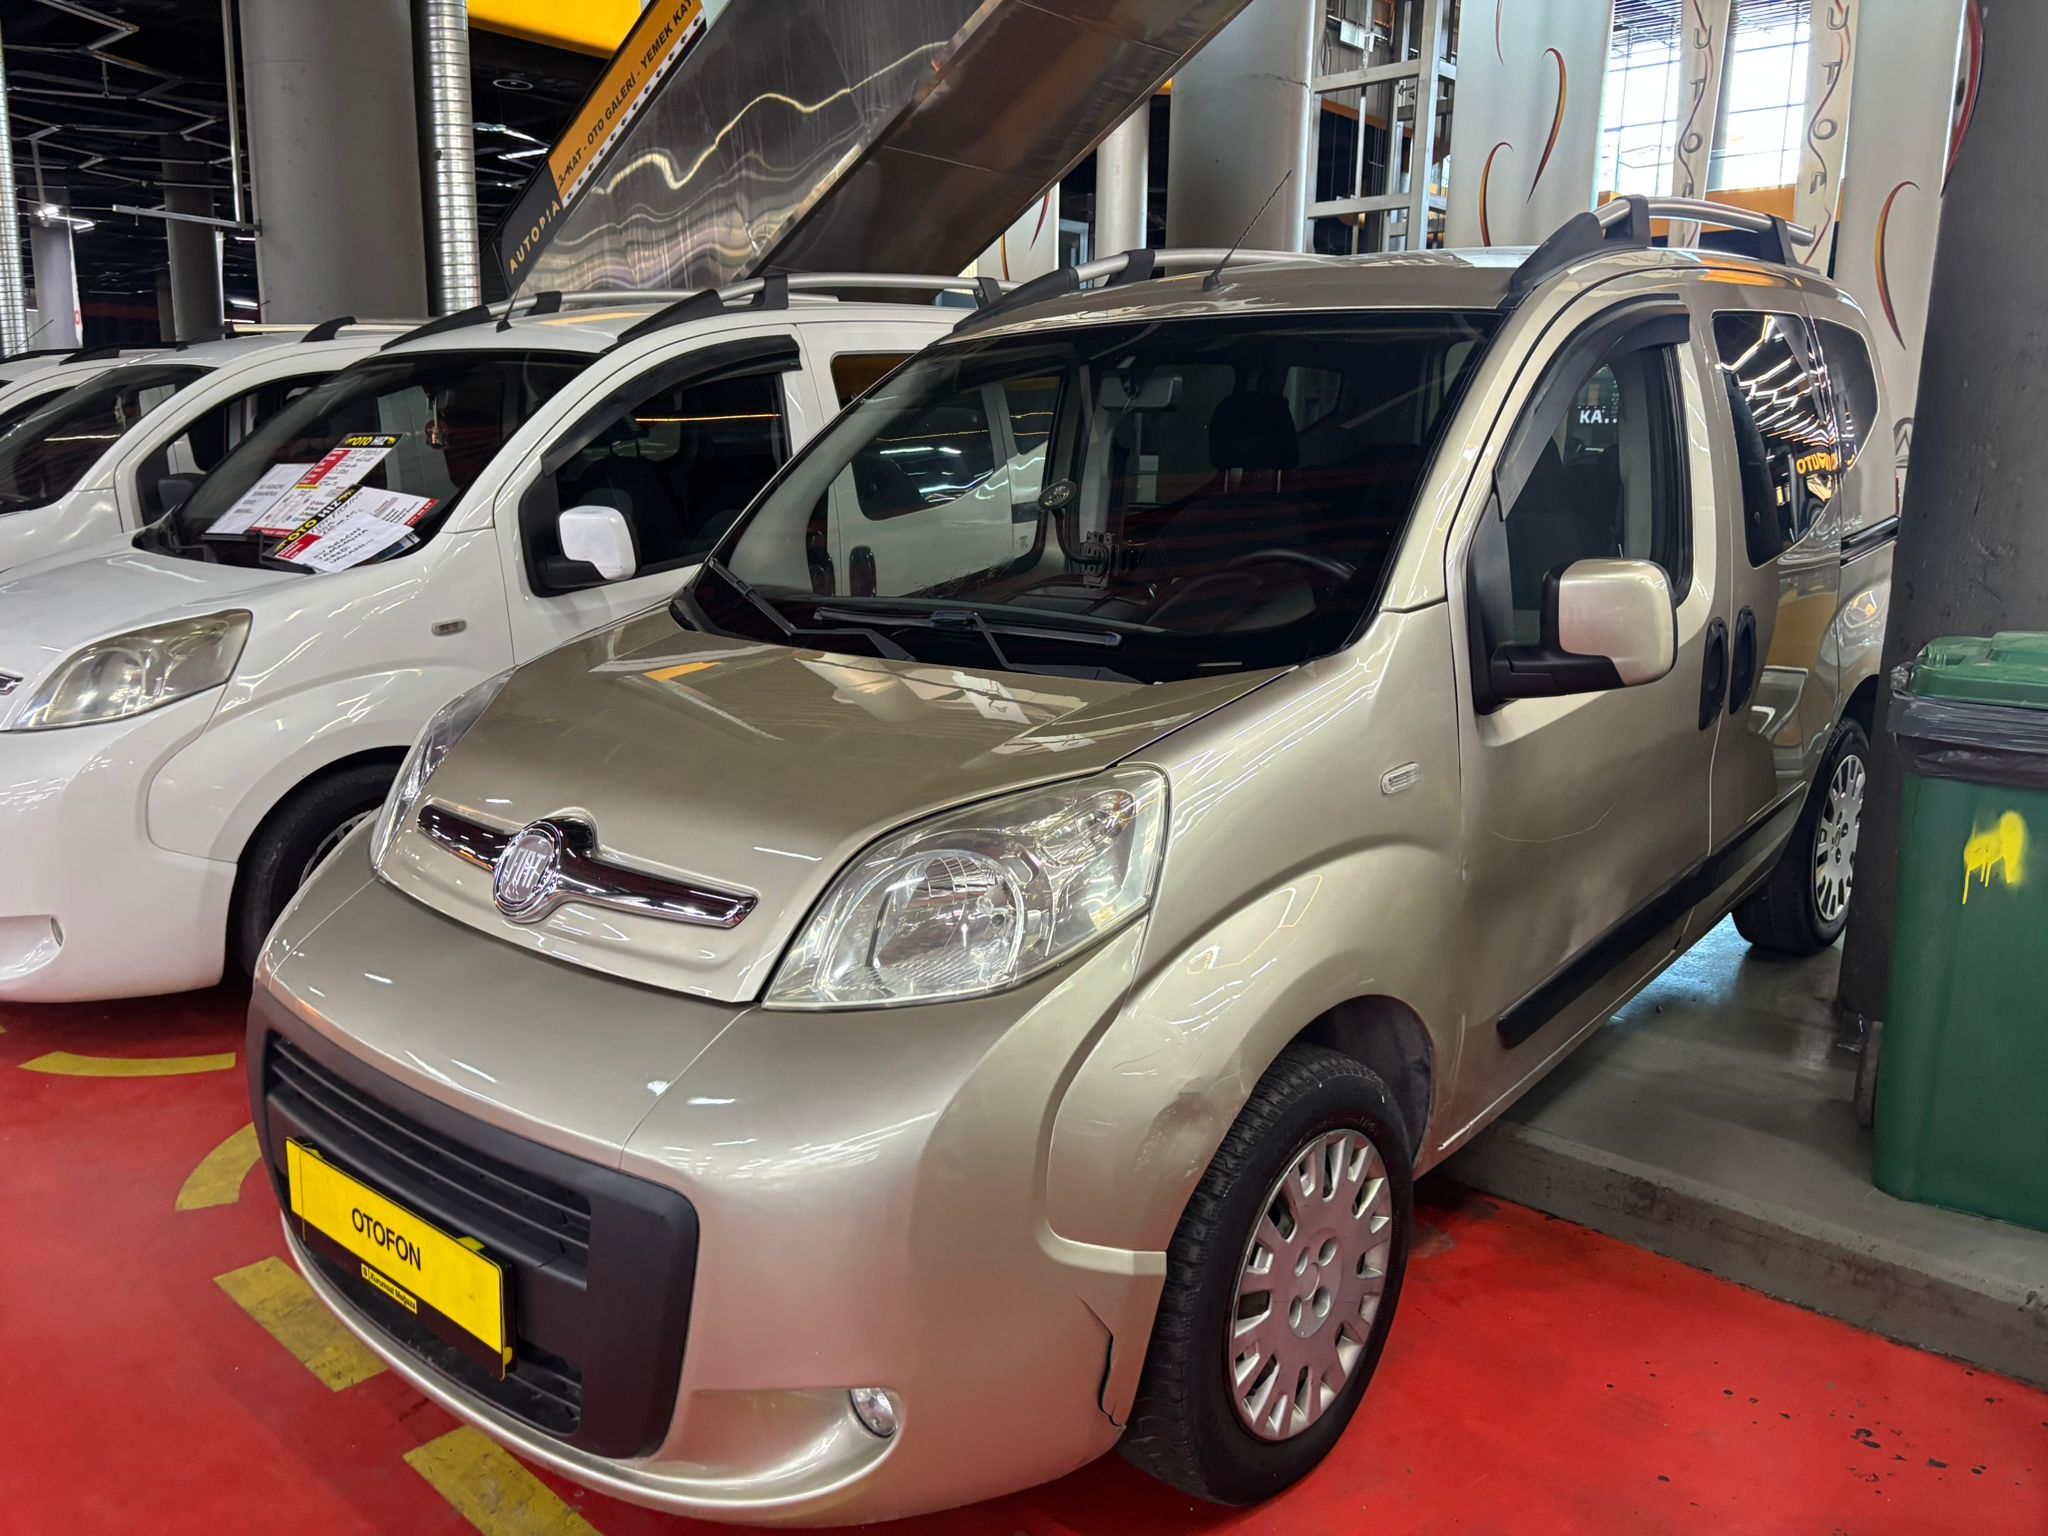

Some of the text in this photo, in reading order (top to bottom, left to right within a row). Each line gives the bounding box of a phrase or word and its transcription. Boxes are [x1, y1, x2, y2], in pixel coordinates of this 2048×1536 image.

[588, 119, 605, 145] OTO
[640, 22, 673, 69] YEMEK
[672, 0, 695, 26] KAT
[287, 519, 317, 541] OTO
[317, 500, 342, 518] HIZ
[351, 1207, 422, 1272] OTOFON
